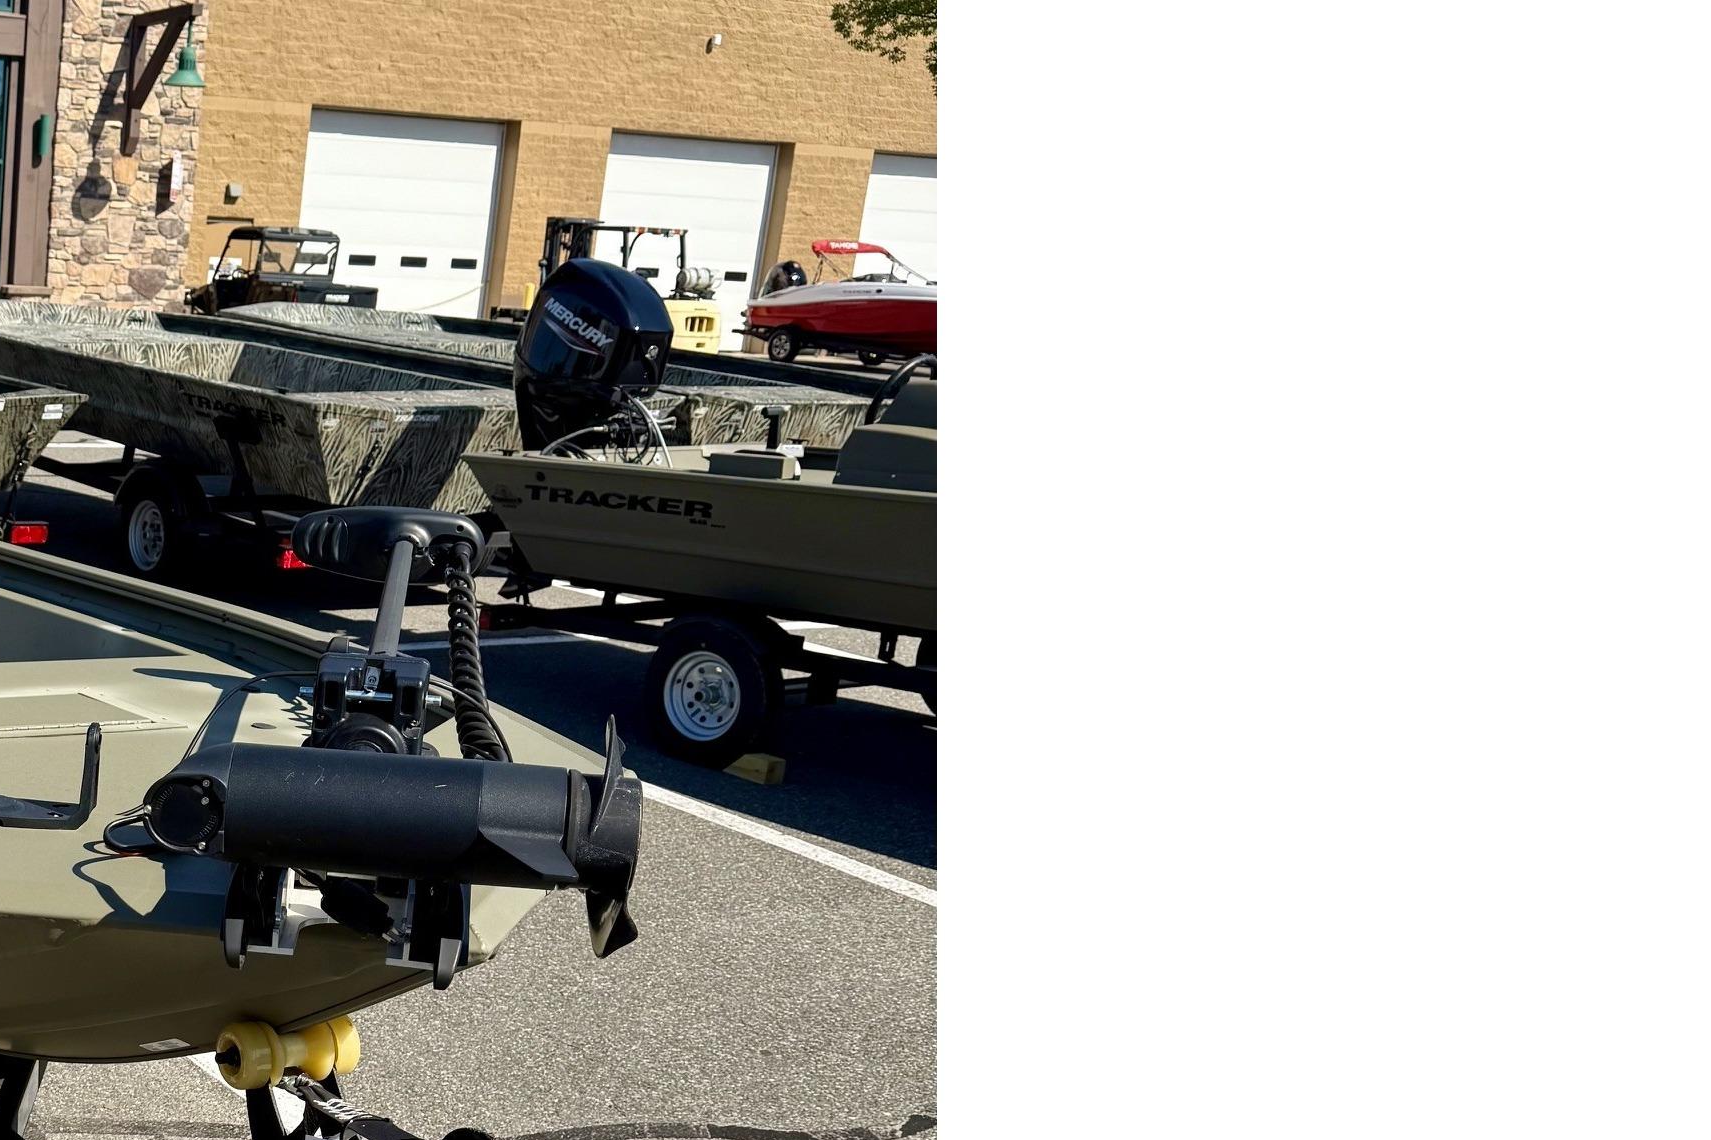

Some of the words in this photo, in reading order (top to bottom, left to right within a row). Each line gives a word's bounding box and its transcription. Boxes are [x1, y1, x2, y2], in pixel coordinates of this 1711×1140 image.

[544, 297, 614, 347] MERCURY
[394, 414, 441, 422] TRACKER
[525, 484, 713, 519] TRACKER
